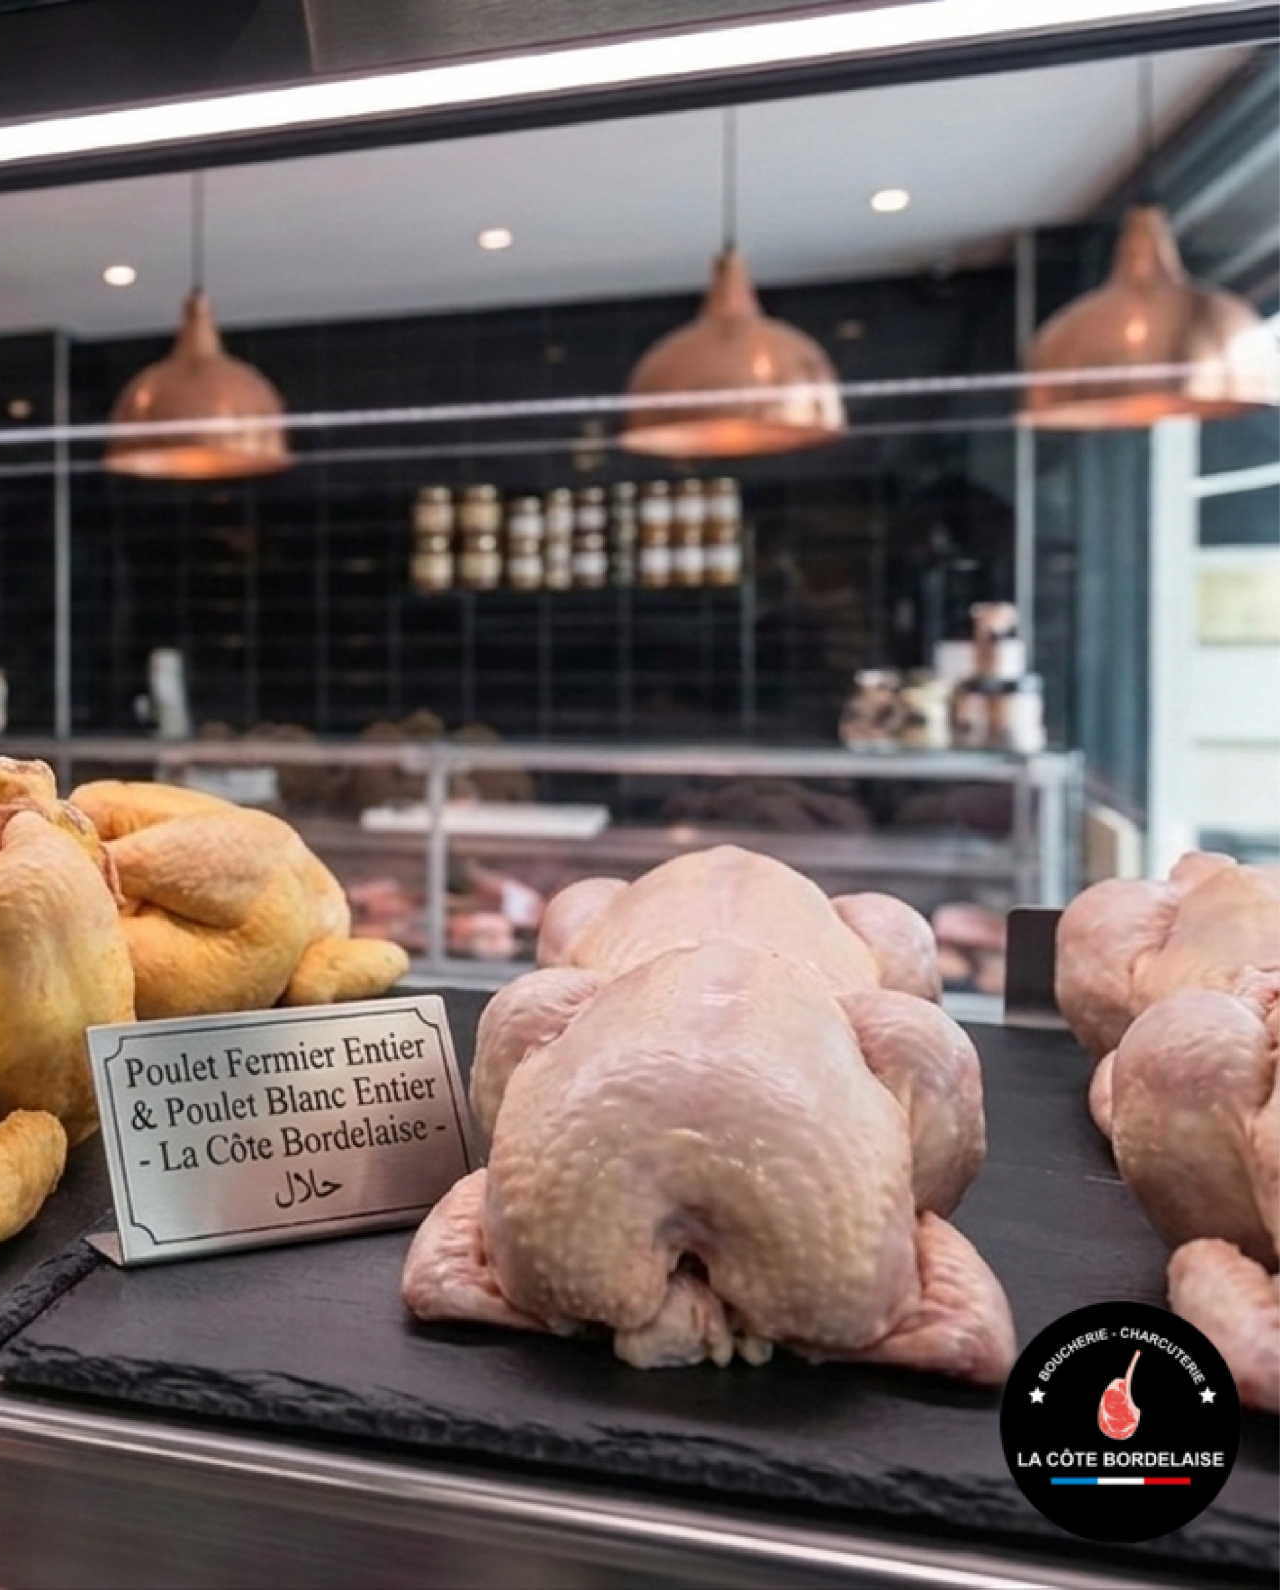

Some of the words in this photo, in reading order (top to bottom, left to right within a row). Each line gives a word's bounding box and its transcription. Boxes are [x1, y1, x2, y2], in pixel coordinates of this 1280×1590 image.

[125, 1053, 218, 1088] Poulet
[225, 1042, 335, 1078] Fermier
[342, 1032, 425, 1067] Entier
[131, 1101, 157, 1131] &
[166, 1093, 258, 1127] Poulet
[265, 1084, 346, 1116] Blanc
[354, 1072, 436, 1105] Entier
[159, 1141, 199, 1172] La
[206, 1133, 273, 1165] Côte
[280, 1115, 428, 1157] Bordelaise
[275, 1168, 342, 1208] حلال
